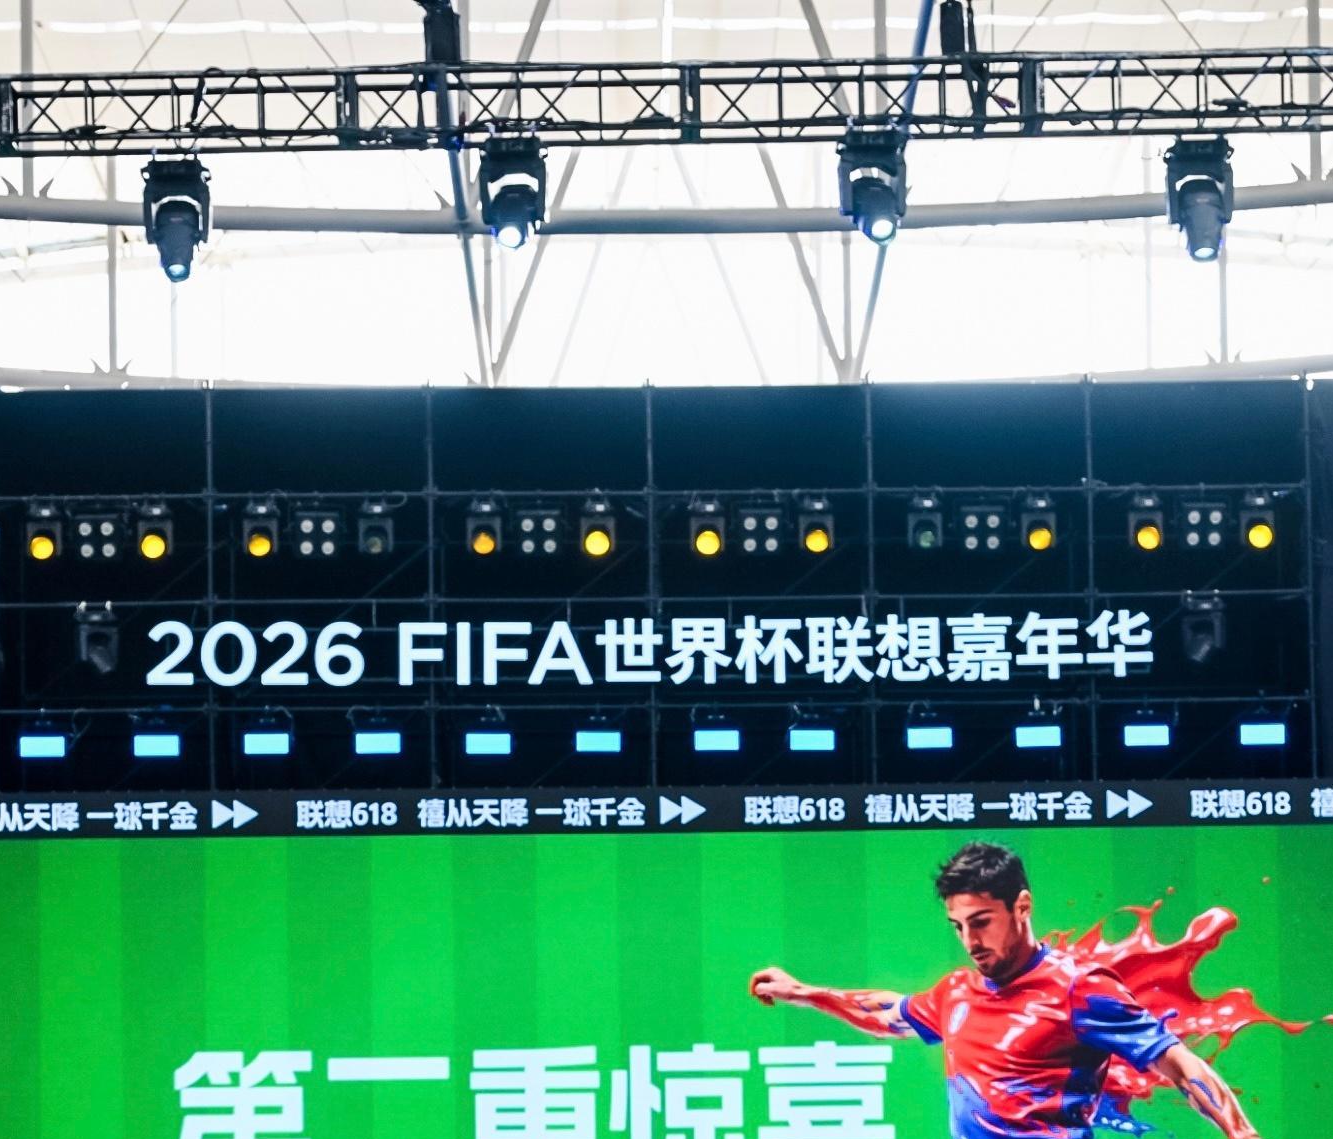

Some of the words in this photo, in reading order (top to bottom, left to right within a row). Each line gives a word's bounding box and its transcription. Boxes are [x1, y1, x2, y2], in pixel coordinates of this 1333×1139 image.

[146, 620, 365, 687] 2026
[398, 608, 1154, 687] FIFA世界杯联想嘉年华
[86, 801, 198, 831] 一球千金
[296, 800, 398, 829] 联想618
[417, 799, 529, 828] 禧从天降
[535, 798, 646, 828] 一球千金
[744, 796, 846, 824] 联想618
[865, 793, 975, 823] 禧从天降
[981, 792, 1092, 822] 一球千金
[1190, 789, 1292, 818] 联想618
